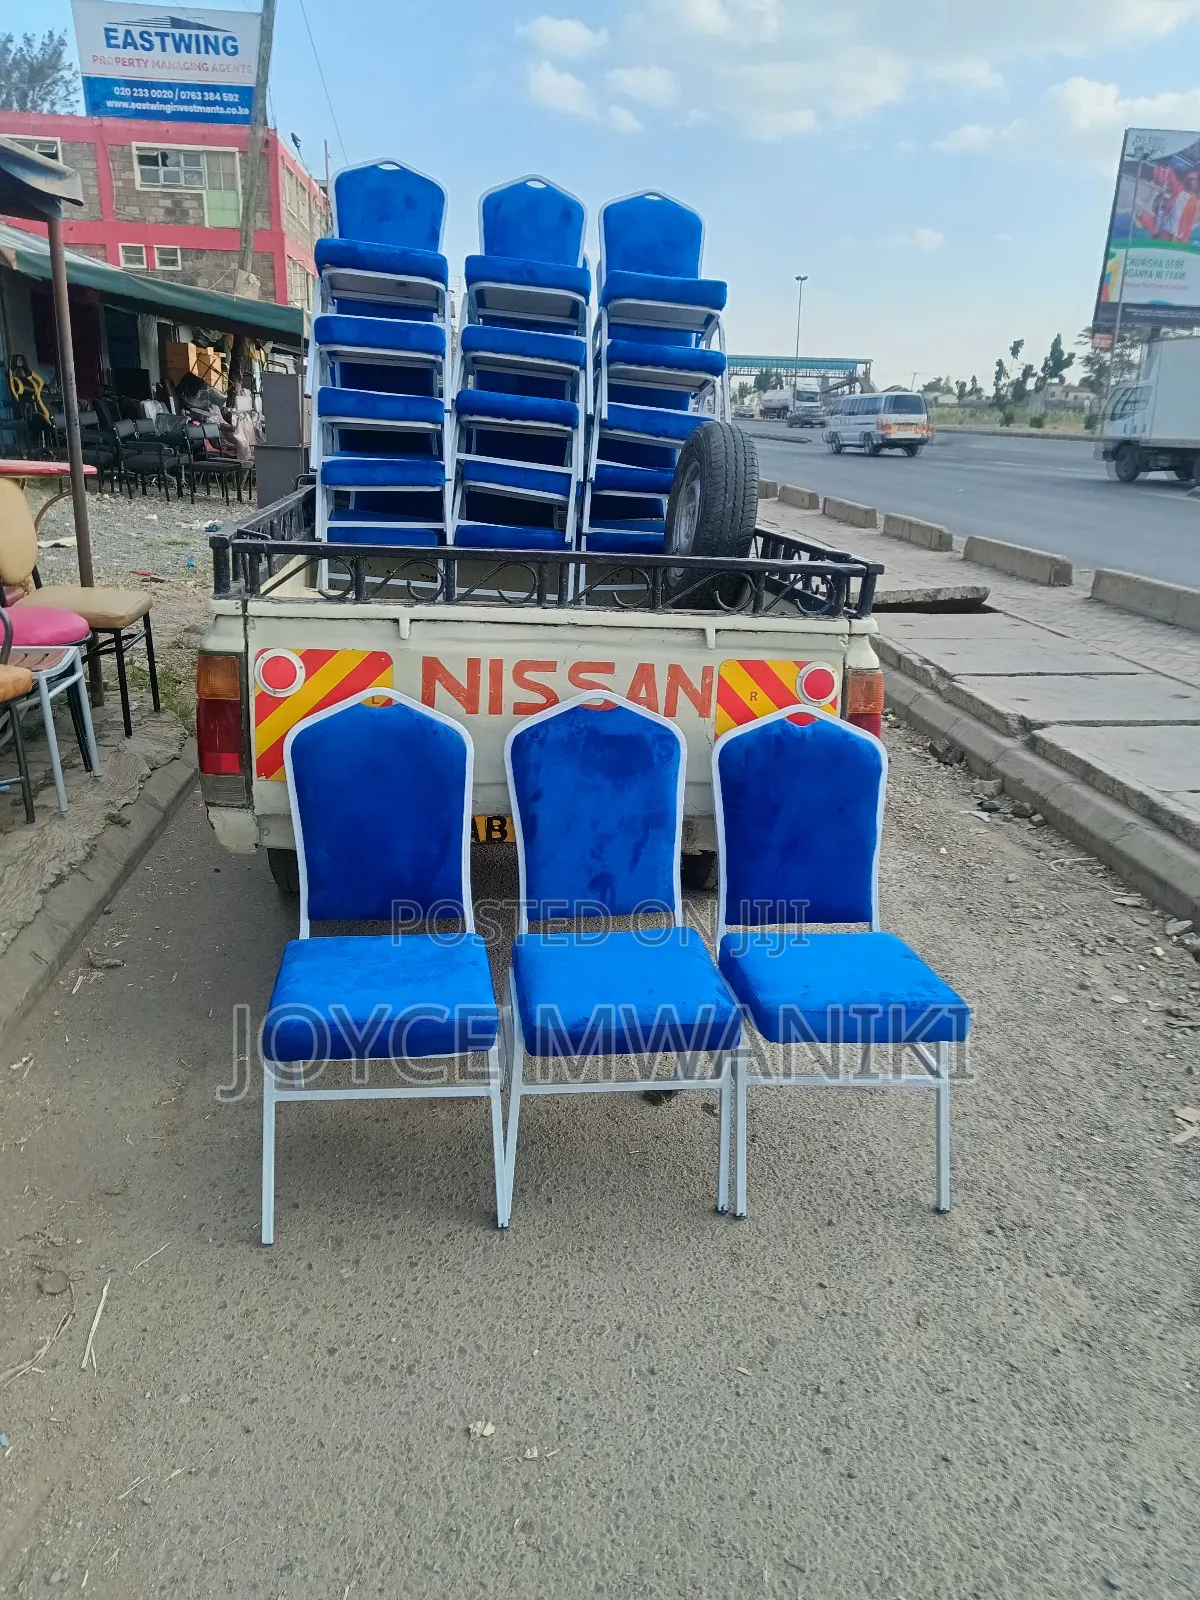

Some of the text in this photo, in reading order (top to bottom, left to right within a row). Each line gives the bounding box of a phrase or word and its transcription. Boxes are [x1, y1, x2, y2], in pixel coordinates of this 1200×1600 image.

[103, 26, 239, 57] EASTWING
[92, 55, 252, 74] PROPERTY MANAGING AGENTS
[113, 86, 131, 96] 020
[133, 87, 149, 97] 233
[150, 89, 173, 99] 0020
[106, 99, 250, 116] www.eastwinginvestments.co.ke
[421, 656, 715, 718] NISSAN
[371, 696, 380, 705] L
[749, 691, 758, 701] R
